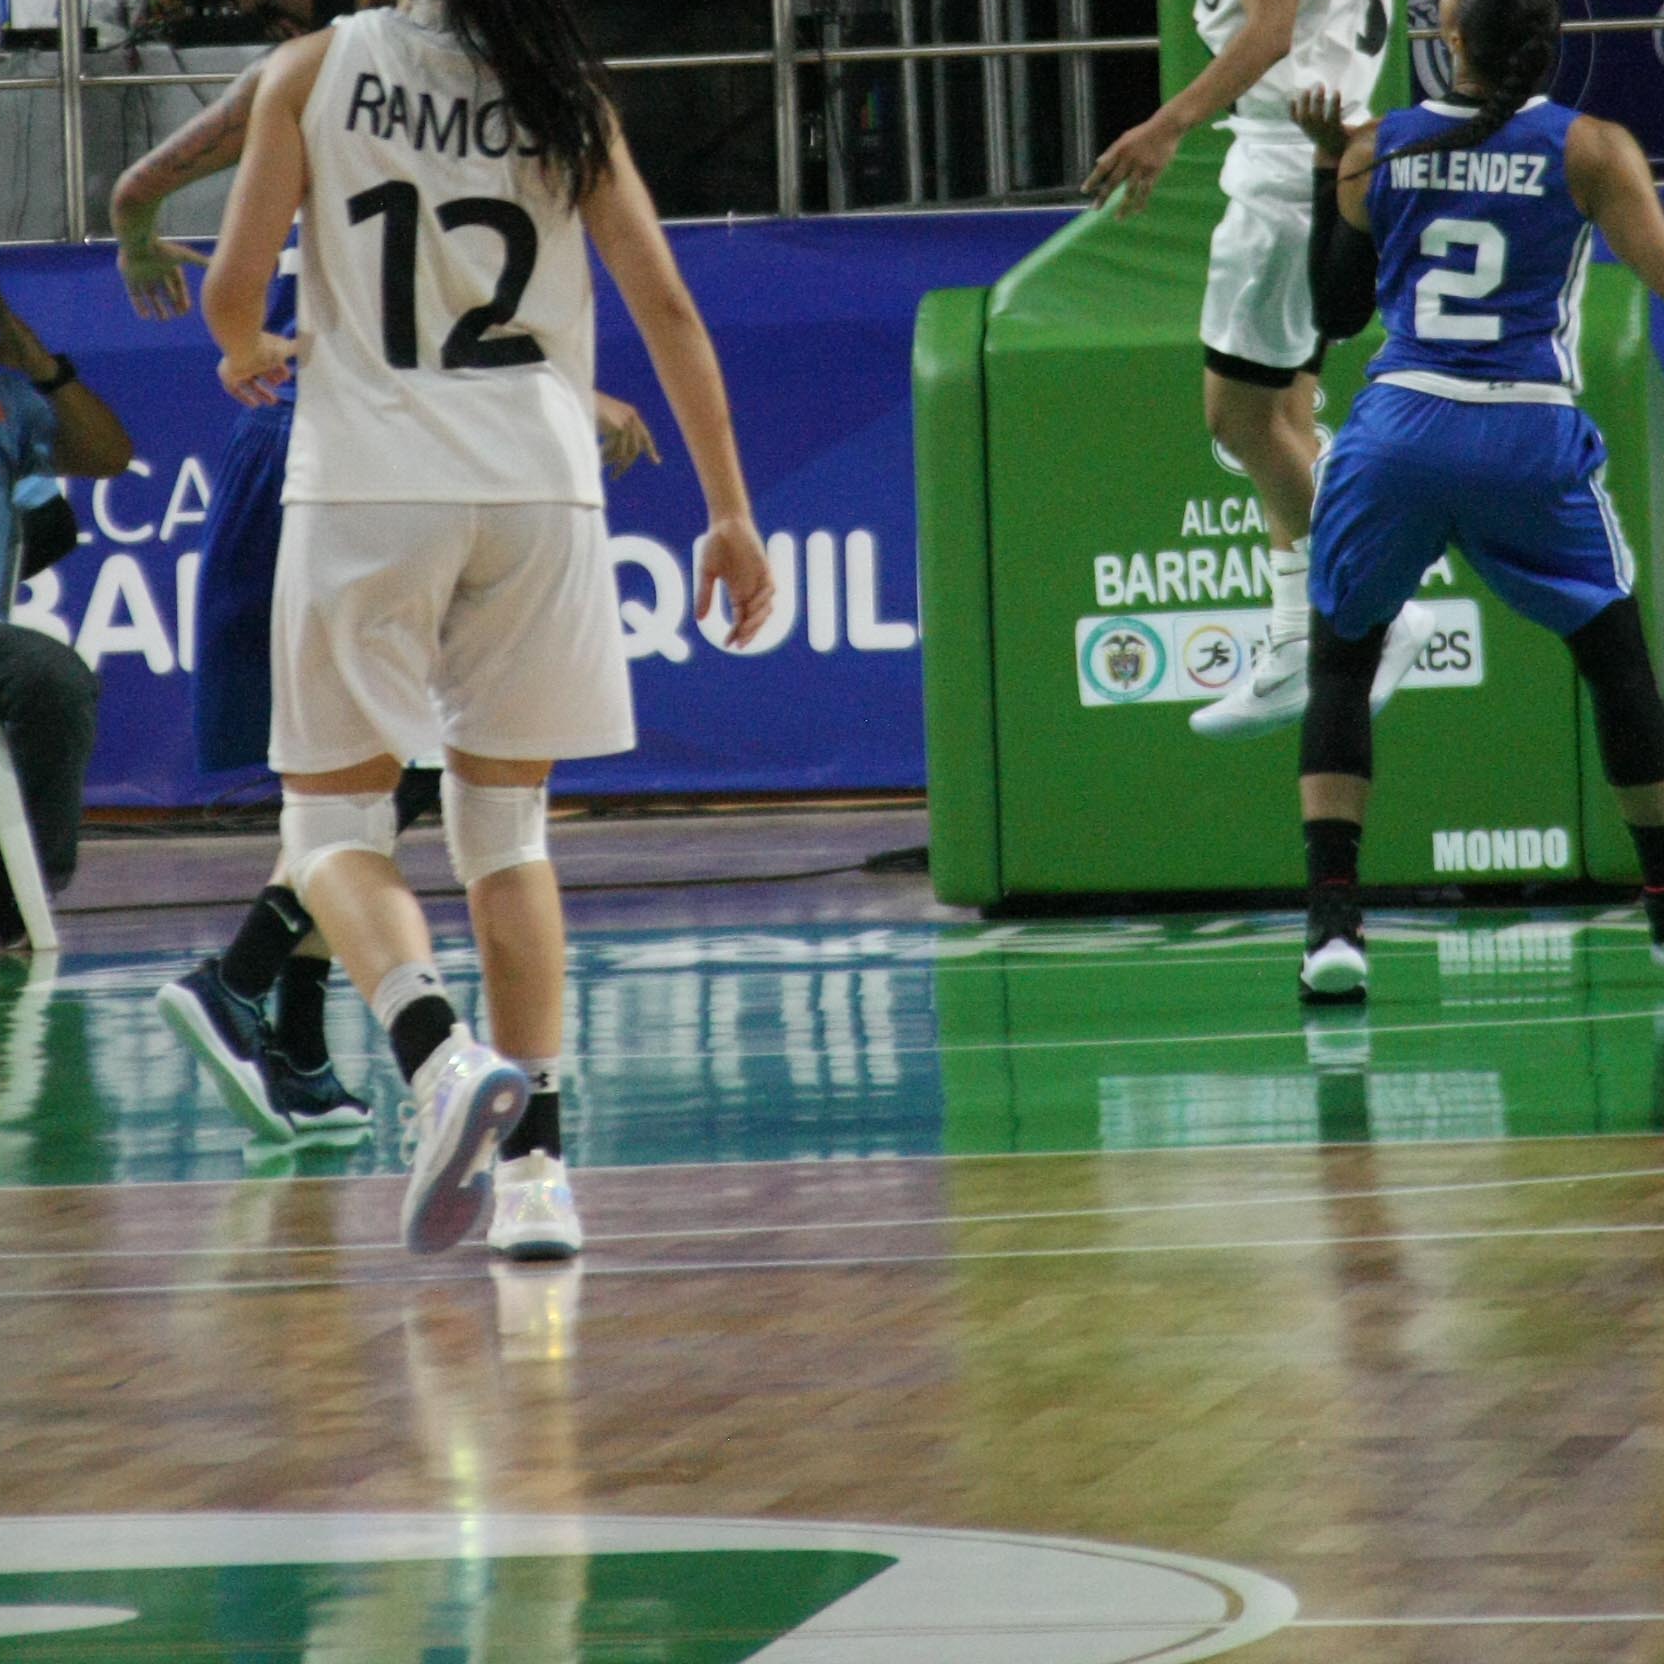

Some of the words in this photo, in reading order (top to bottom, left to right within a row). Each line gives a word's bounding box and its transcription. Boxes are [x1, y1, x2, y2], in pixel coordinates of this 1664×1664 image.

[1391, 151, 1547, 198] MELENDEZ
[348, 180, 546, 370] 12
[1414, 217, 1509, 343] 2
[1431, 827, 1572, 873] MONDO
